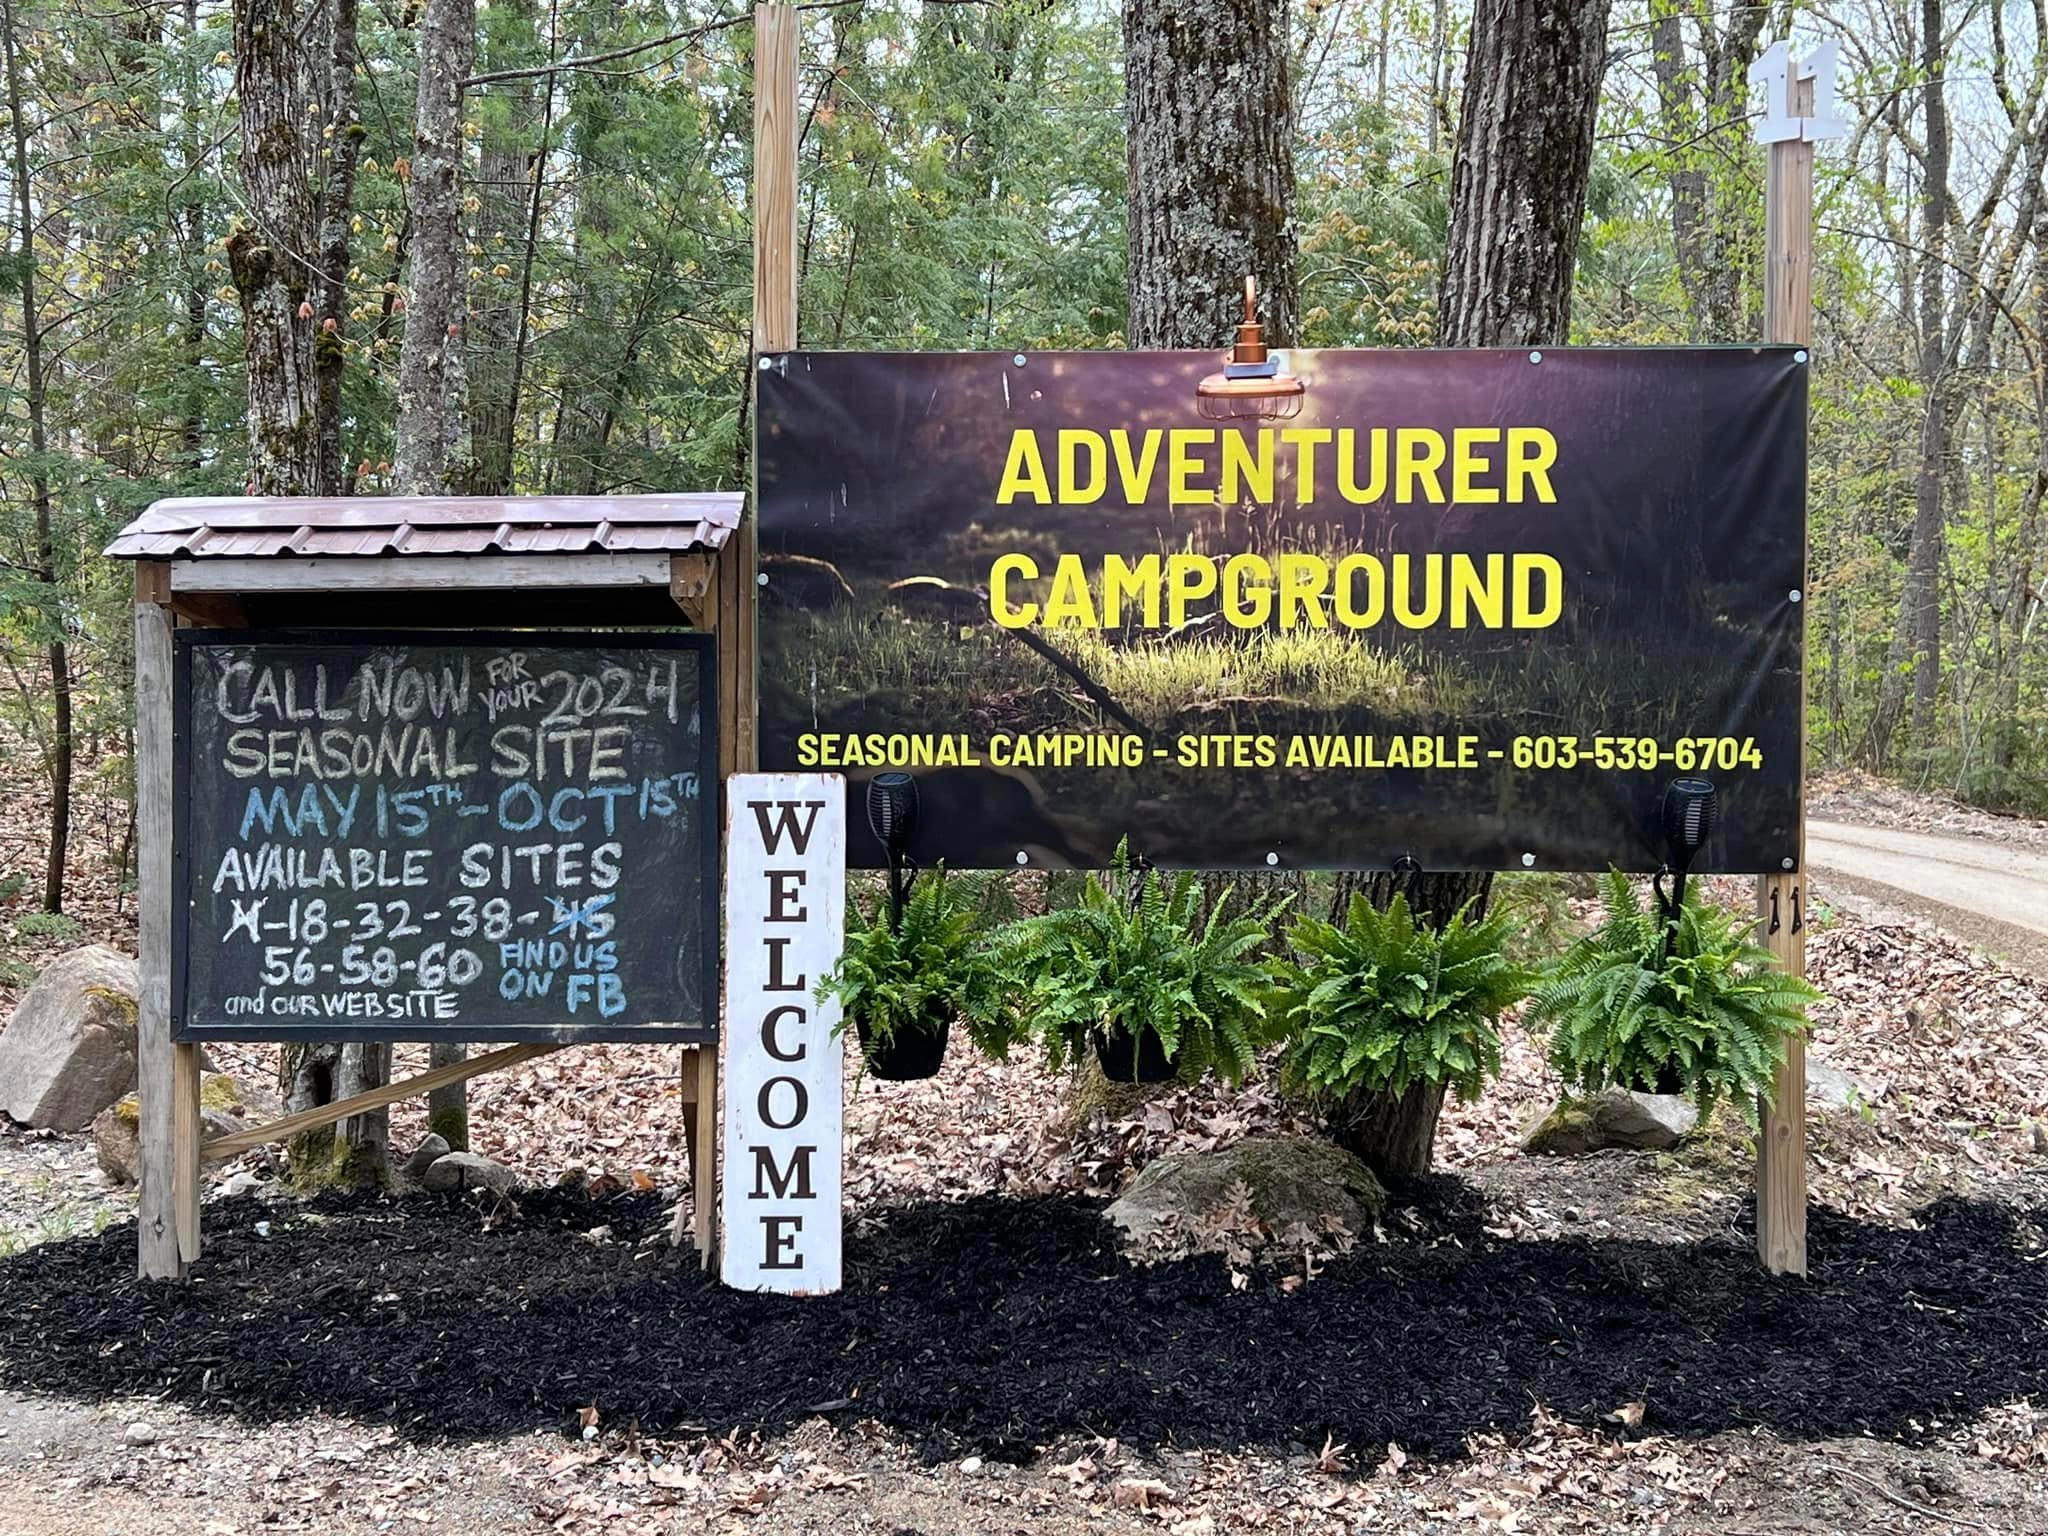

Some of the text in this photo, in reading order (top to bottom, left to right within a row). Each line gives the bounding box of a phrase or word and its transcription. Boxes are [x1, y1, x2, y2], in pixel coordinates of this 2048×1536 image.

[1747, 39, 1850, 145] 11
[996, 427, 1558, 505] ADVENTURER
[990, 552, 1563, 630] CAMPGROUND
[217, 656, 470, 722] CALL NOW
[486, 652, 533, 685] FOR
[540, 659, 679, 728] 2024
[478, 680, 544, 723] YOUR
[222, 723, 632, 781] SEASONAL SITE
[797, 733, 980, 767] SEASONAL
[989, 734, 1143, 767] CAMPING
[1177, 735, 1276, 767] SITES
[1285, 736, 1478, 768] AVAILABLE
[1513, 736, 1763, 770] 603-539-6704
[239, 785, 361, 841] MAY
[498, 782, 636, 836] OCT
[212, 842, 623, 893] AVAILABLE SITES
[1768, 886, 1803, 936] 11
[258, 942, 484, 987] 56-58-60
[499, 938, 619, 971] FIND US
[224, 986, 267, 1016] and
[321, 988, 461, 1019] WEBSITE
[499, 967, 627, 1017] ON FB
[747, 800, 826, 1270] WELCOME
